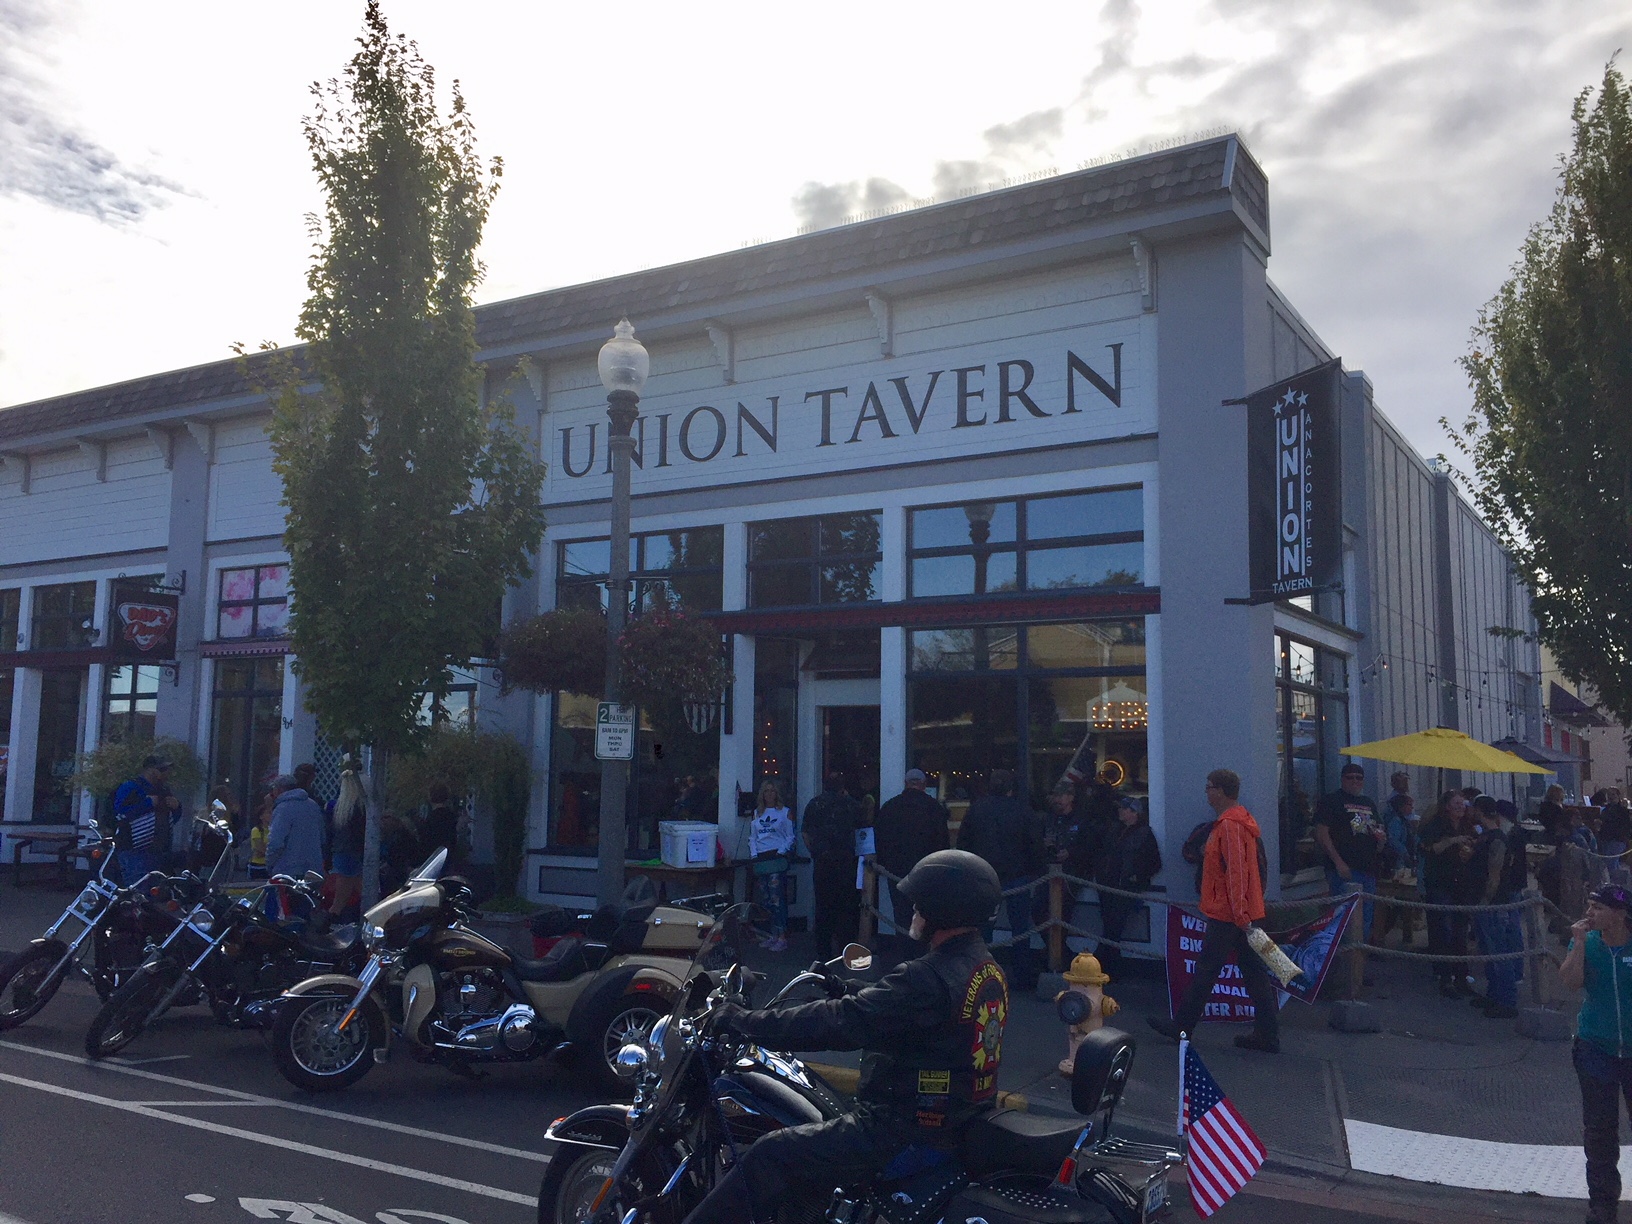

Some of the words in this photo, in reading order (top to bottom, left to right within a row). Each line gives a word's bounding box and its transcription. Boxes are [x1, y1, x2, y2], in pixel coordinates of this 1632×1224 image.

[558, 395, 780, 478] UNION
[803, 342, 1124, 447] TAVERN
[1281, 414, 1300, 575] UNION
[1304, 413, 1313, 567] ANACORTES
[1272, 576, 1313, 594] TAVERN
[600, 707, 609, 722] 2
[609, 714, 632, 723] PARKING
[1179, 935, 1203, 953] BIK
[961, 971, 983, 1019] VETERANS
